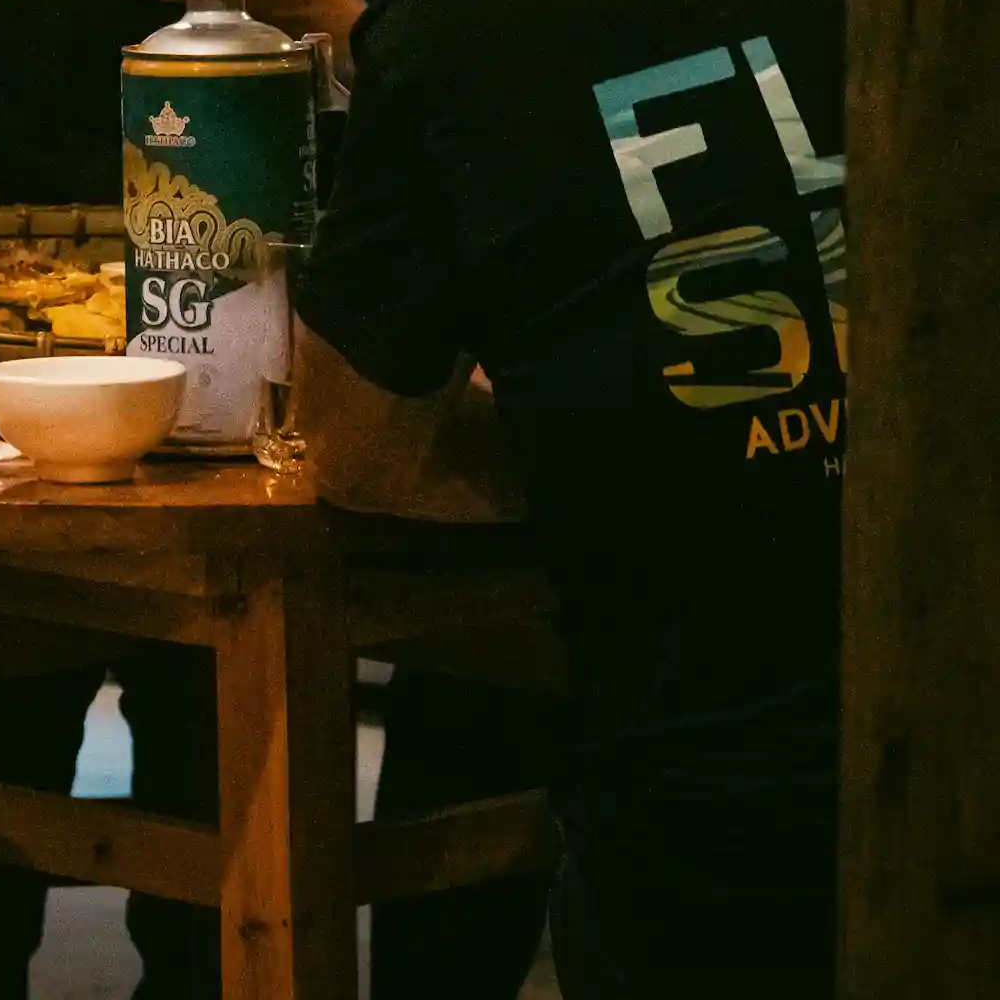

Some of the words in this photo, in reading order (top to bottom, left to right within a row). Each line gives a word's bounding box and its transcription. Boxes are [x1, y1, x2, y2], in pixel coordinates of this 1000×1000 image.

[150, 218, 195, 245] BIA
[134, 248, 230, 270] HATHACO
[141, 276, 212, 329] SG
[140, 335, 214, 354] SPECIAL
